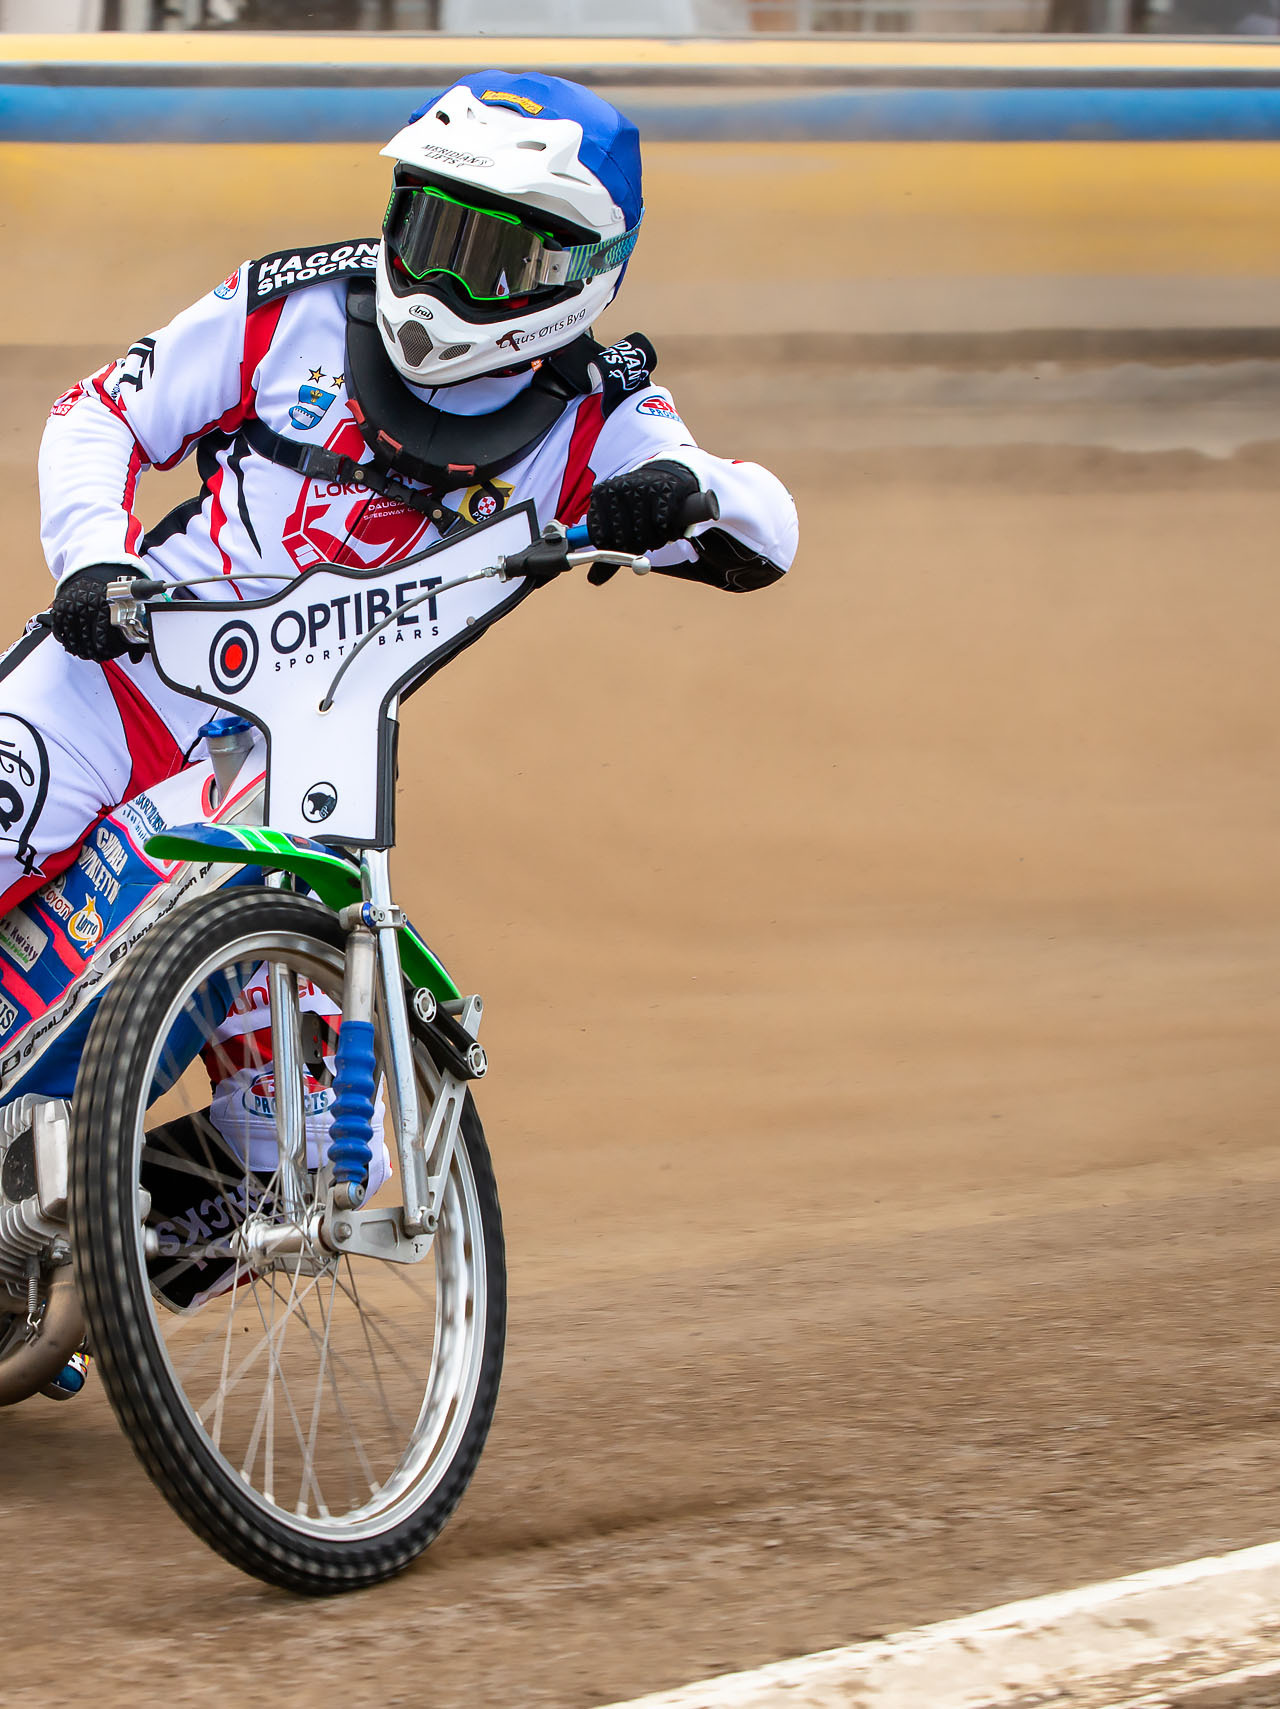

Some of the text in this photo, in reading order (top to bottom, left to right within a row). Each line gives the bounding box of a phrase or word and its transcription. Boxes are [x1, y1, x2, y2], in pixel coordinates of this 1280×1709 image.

[258, 243, 380, 282] HAGON
[257, 256, 378, 296] SHOCKS
[412, 304, 430, 318] Arai
[566, 308, 587, 326] Byg
[270, 576, 443, 654] OPTIBET
[379, 626, 439, 646] BĀRS
[76, 914, 99, 936] LOTTO
